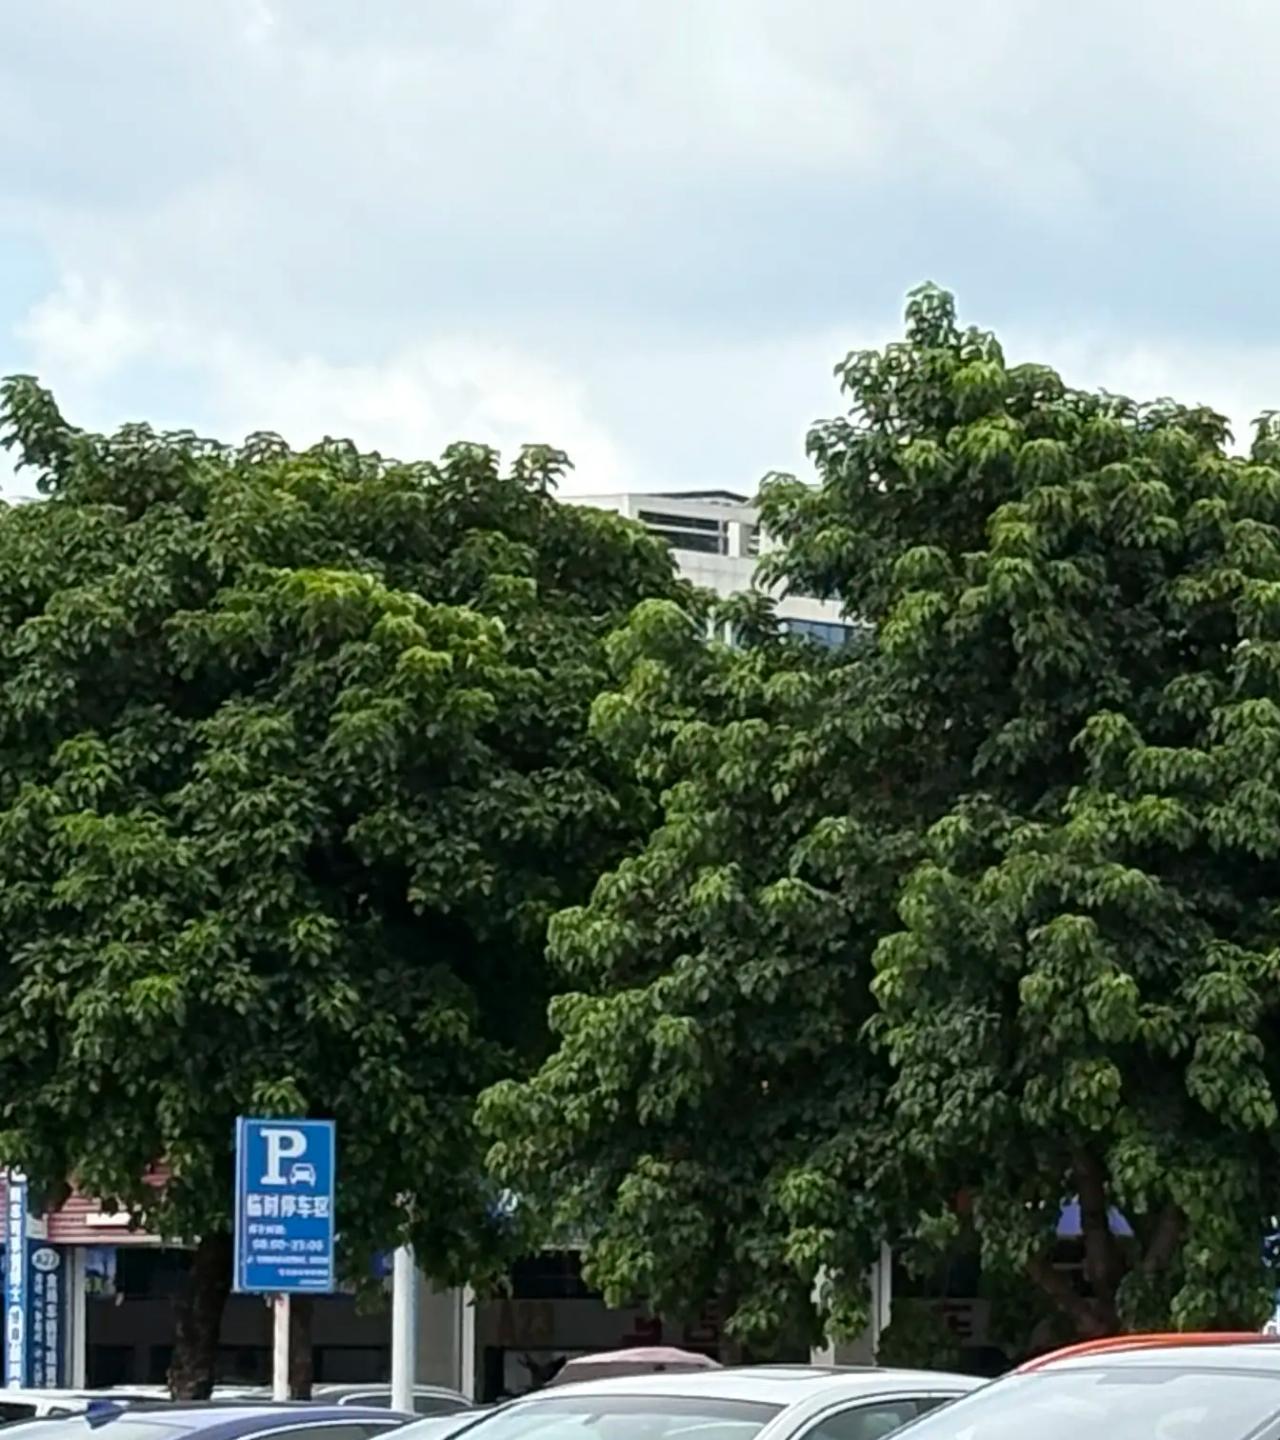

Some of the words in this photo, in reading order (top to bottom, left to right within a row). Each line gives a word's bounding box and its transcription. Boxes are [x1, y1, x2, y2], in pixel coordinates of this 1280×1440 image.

[259, 1128, 308, 1186] P
[247, 1193, 330, 1219] 临时停车区
